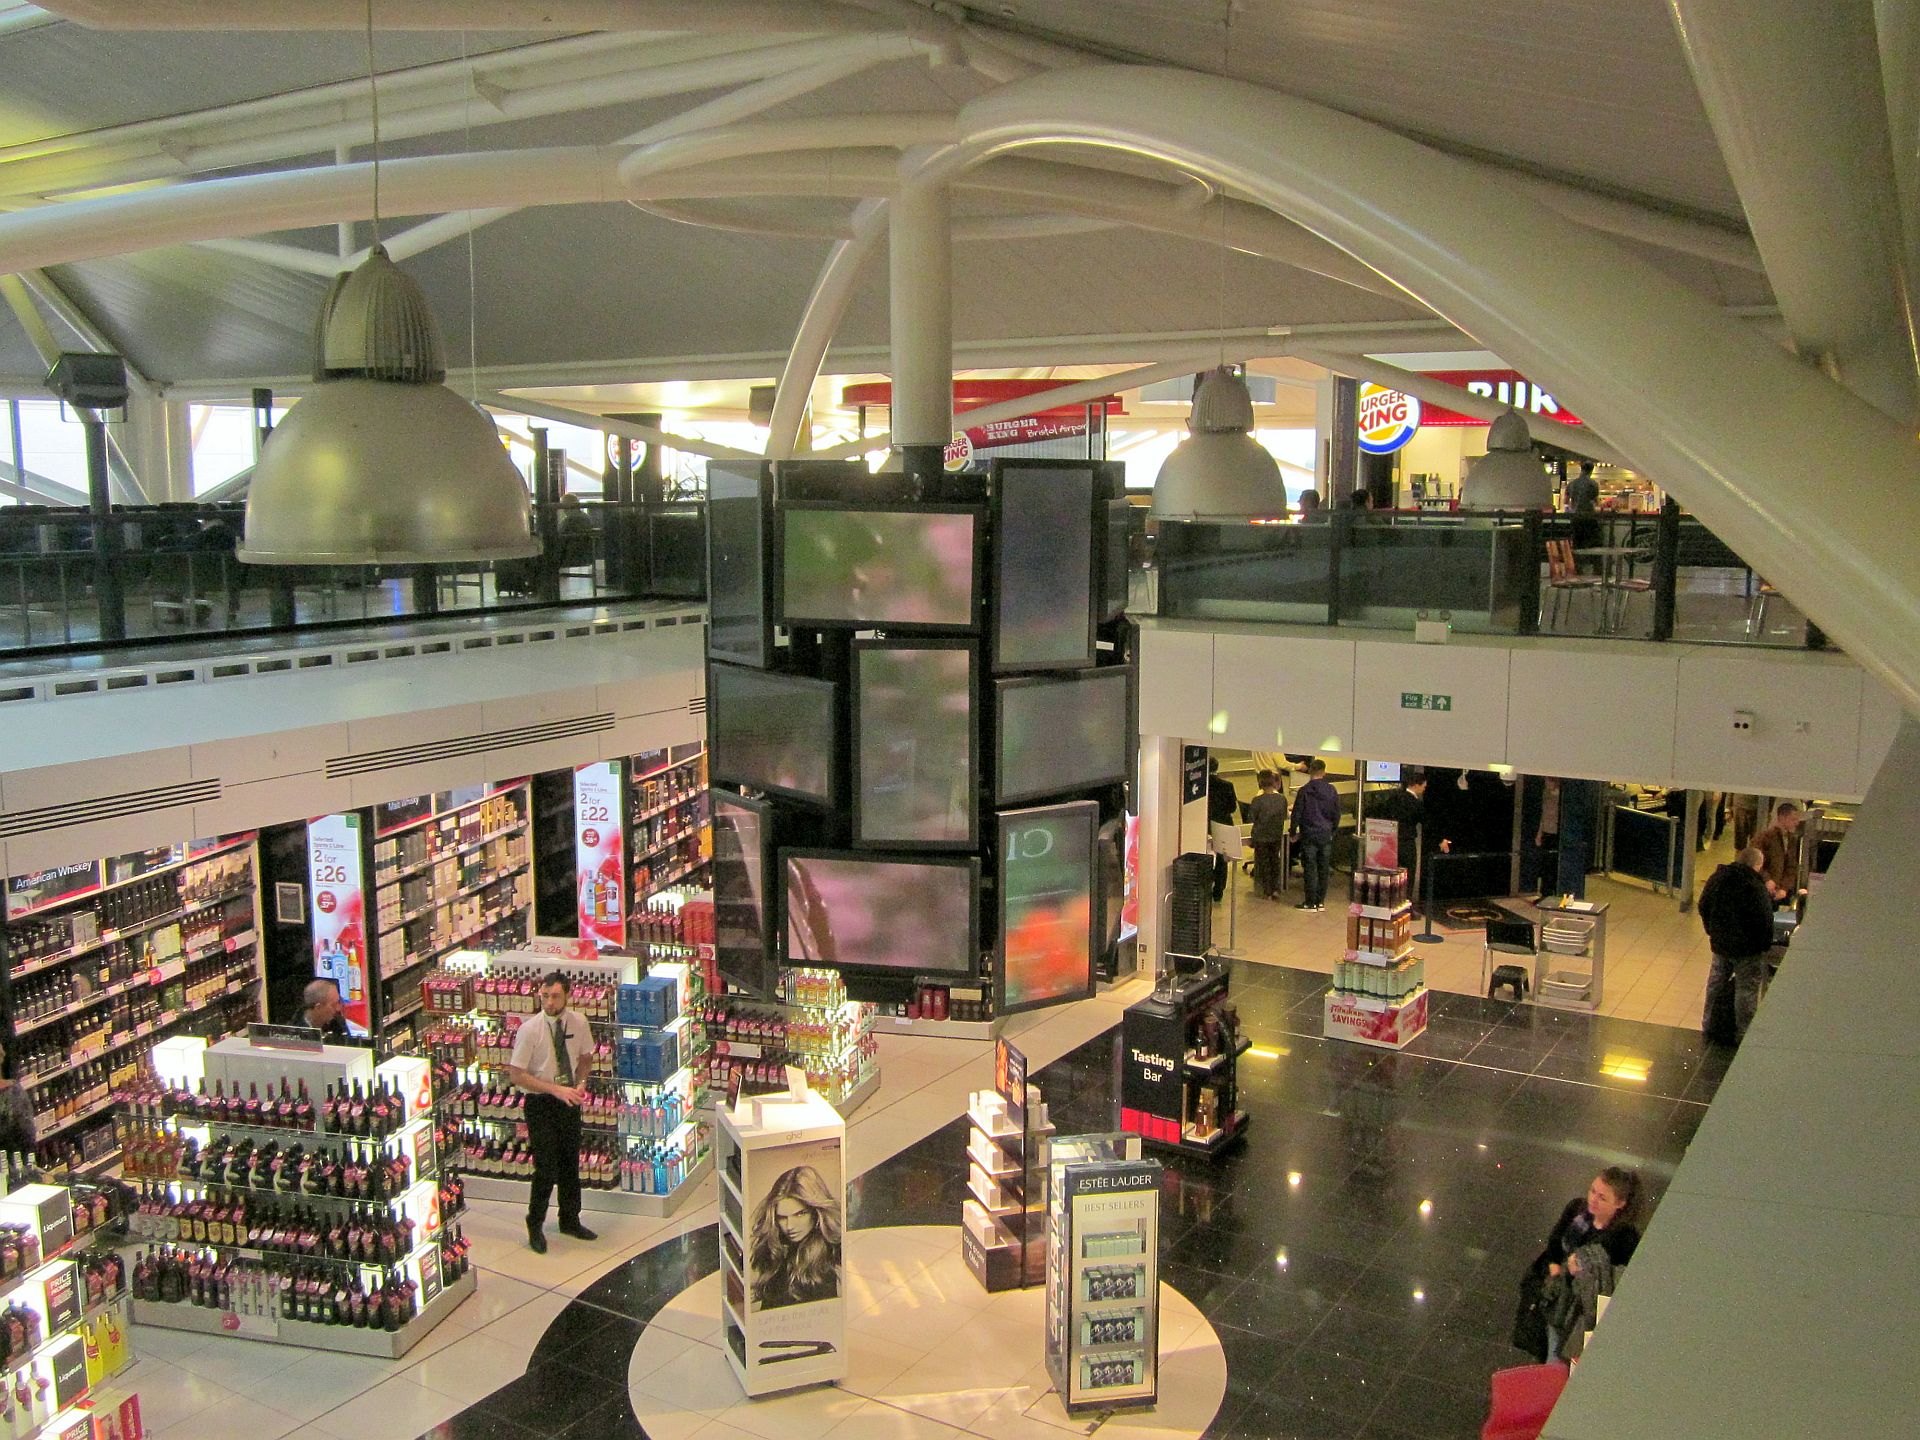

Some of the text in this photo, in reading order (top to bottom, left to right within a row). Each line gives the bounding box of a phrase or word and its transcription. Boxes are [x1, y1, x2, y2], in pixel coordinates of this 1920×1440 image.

[1360, 391, 1406, 413] URGER
[985, 418, 1038, 431] BURGER
[987, 422, 1088, 440] KING Bristol Airpor
[580, 793, 601, 805] 2 for
[581, 806, 609, 821] £22
[313, 849, 337, 863] 2 for
[16, 860, 92, 890] American Whiskey
[315, 865, 346, 883] £26
[1131, 1048, 1175, 1072] Tasting
[1143, 1067, 1163, 1083] Bar
[785, 1130, 803, 1143] ghd
[1111, 1174, 1152, 1187] LAUDER
[1084, 1200, 1146, 1213] BEST SELLERS
[50, 1270, 72, 1290] PRICE
[66, 1420, 89, 1440] PRICE
